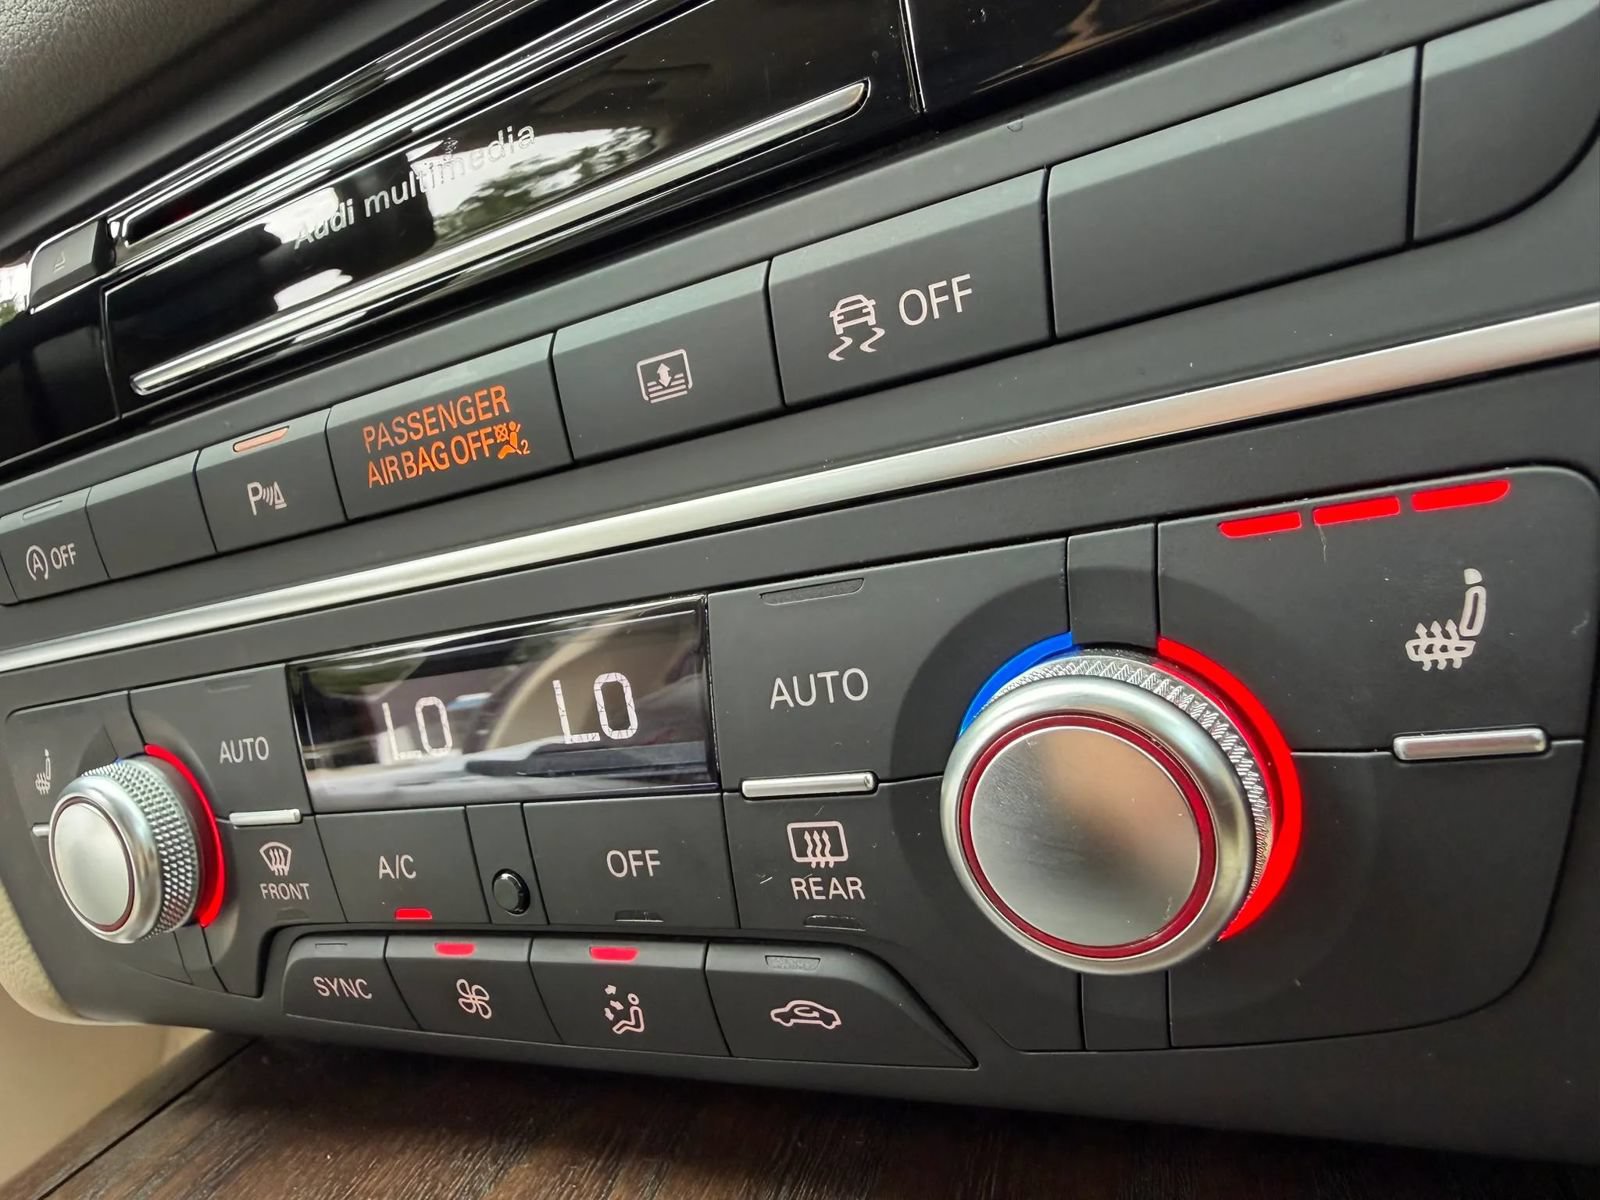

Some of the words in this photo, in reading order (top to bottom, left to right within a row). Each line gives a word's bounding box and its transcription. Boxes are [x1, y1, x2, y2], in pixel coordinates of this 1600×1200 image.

[294, 199, 355, 250] Audi
[364, 125, 535, 217] multimedia
[898, 274, 973, 326] OFF
[362, 385, 511, 453] PASSENGER
[367, 440, 450, 488] AIRBAG
[450, 426, 494, 465] OFF
[50, 543, 77, 570] OFF
[769, 668, 870, 709] AUTO
[381, 696, 453, 761] LO
[552, 671, 638, 744] LO
[219, 736, 270, 764] AUTO
[378, 853, 417, 880] A/C
[605, 849, 662, 878] OFF
[259, 883, 310, 901] FRONT
[791, 876, 866, 901] REAR
[313, 976, 373, 1000] SYNC
